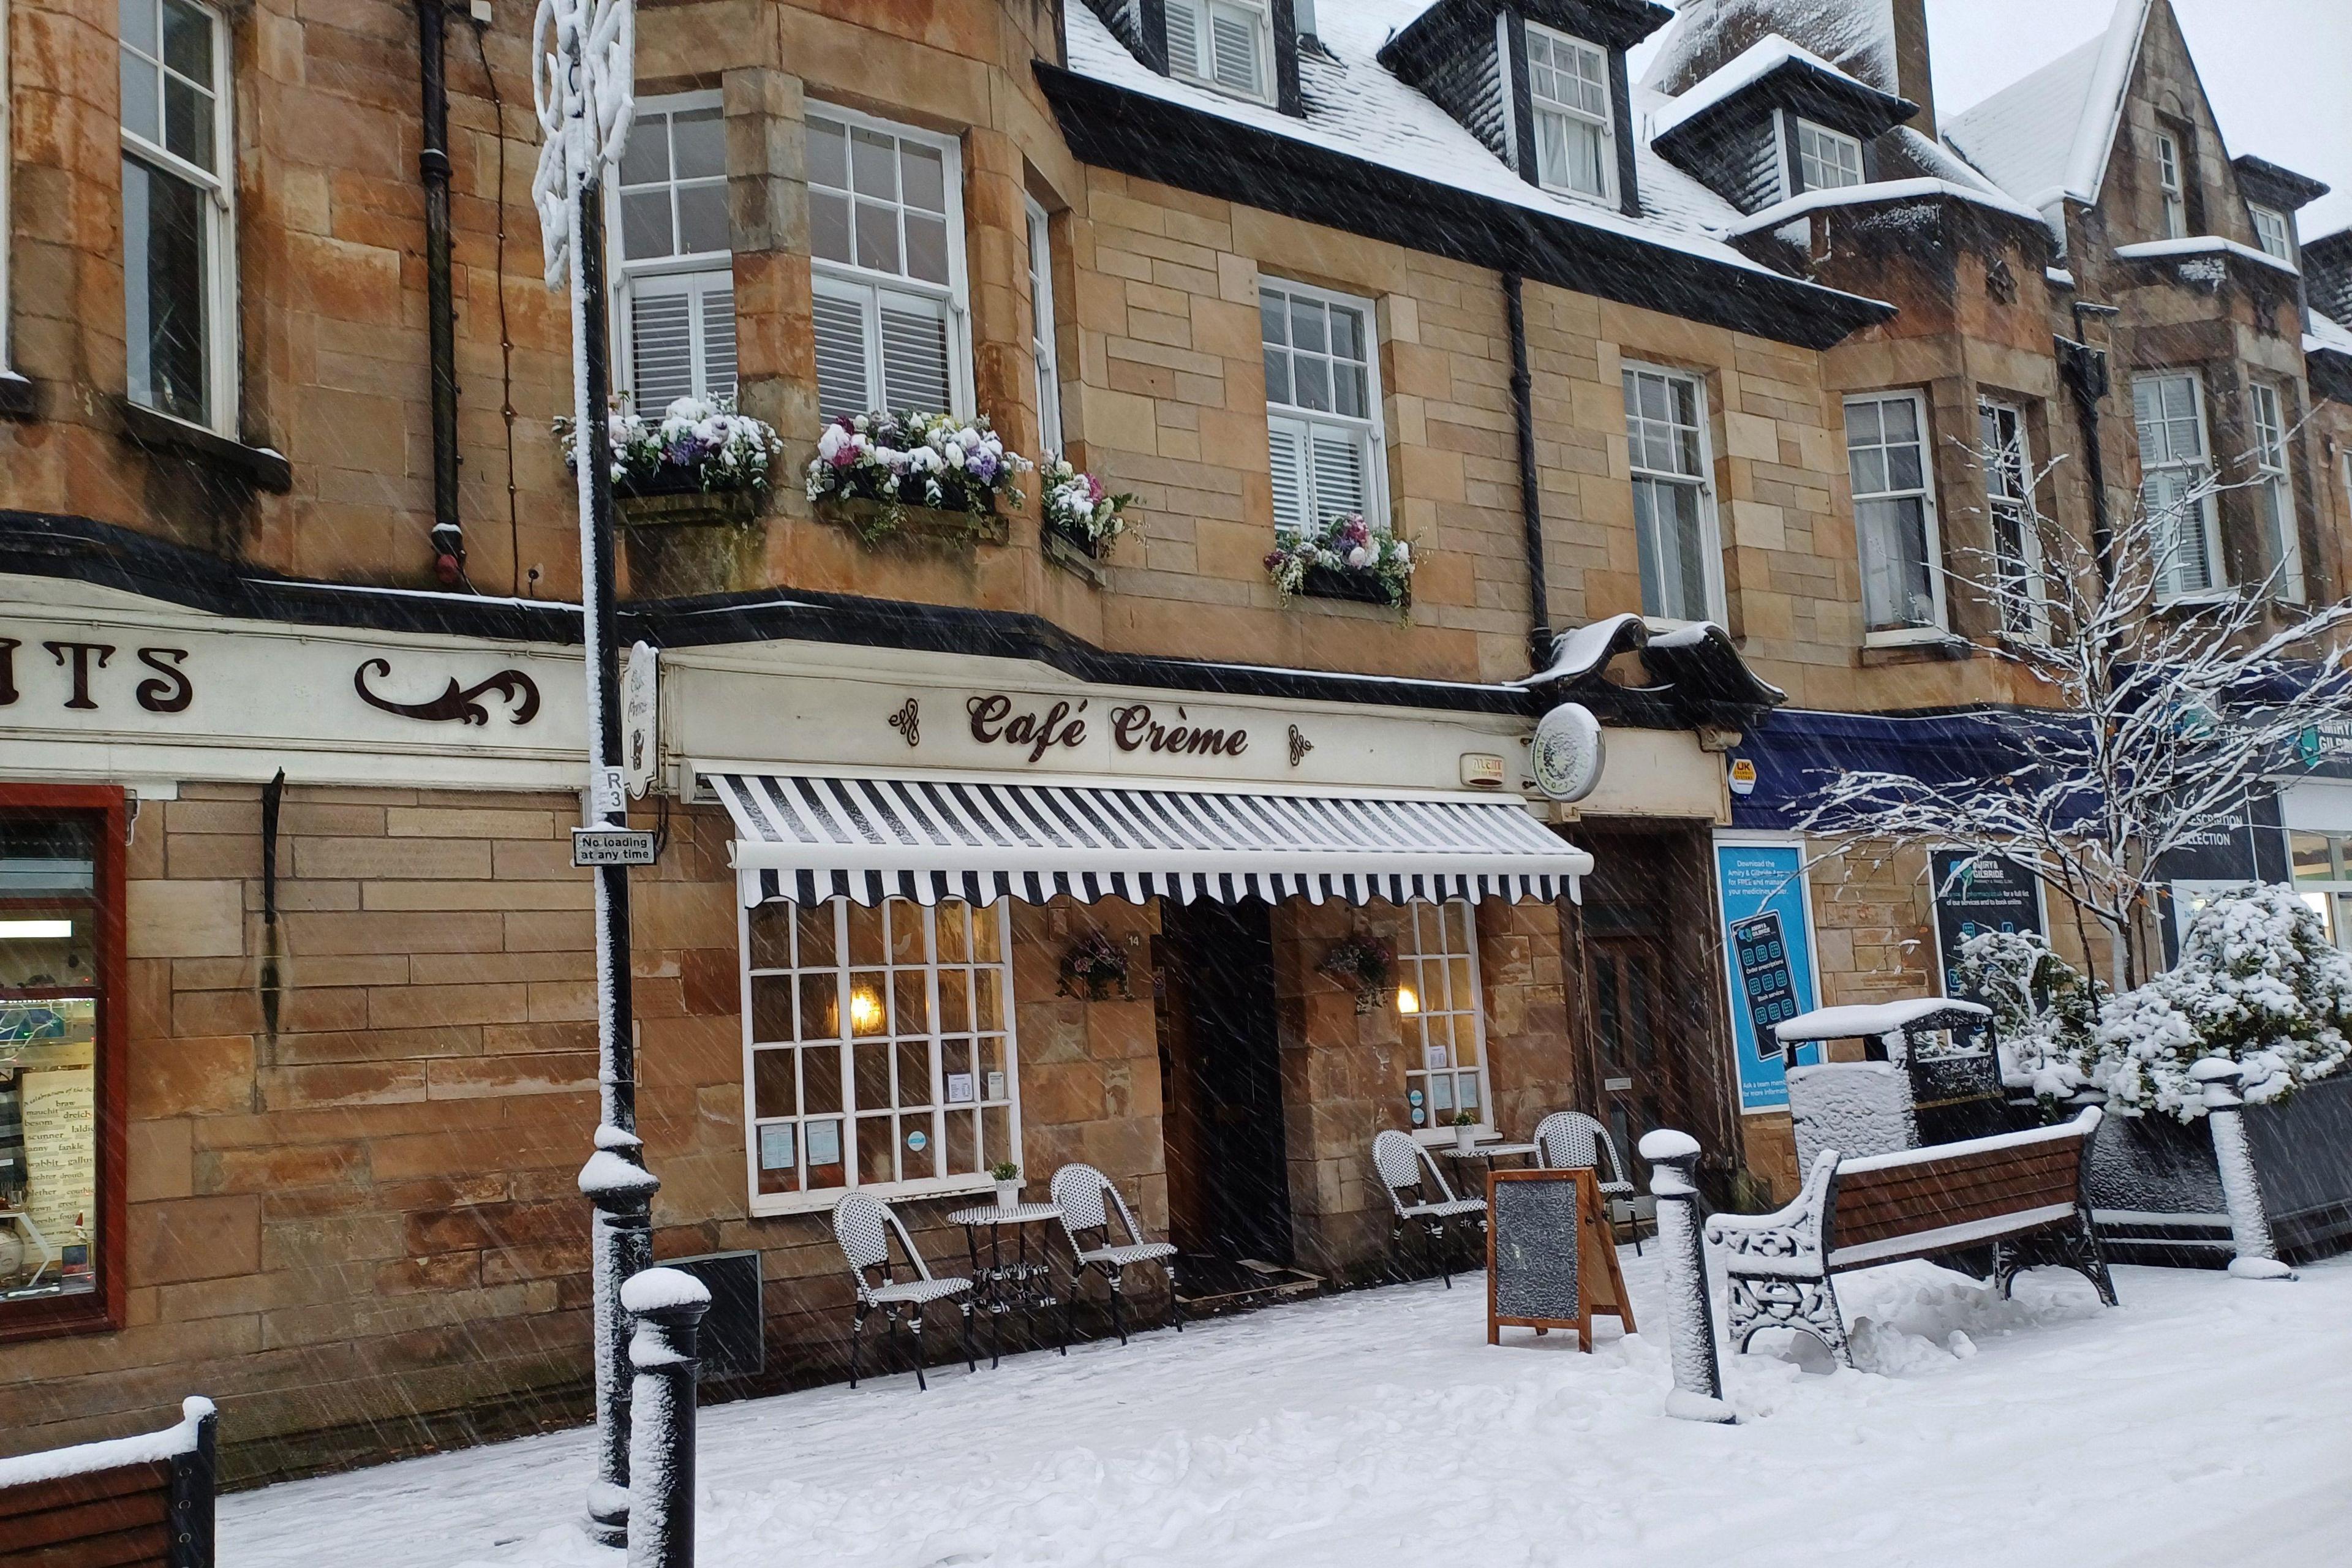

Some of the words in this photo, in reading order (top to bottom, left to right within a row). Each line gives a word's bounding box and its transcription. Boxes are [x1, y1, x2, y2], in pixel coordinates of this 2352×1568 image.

[967, 695, 1088, 763] Café
[1110, 704, 1248, 756] Crème
[1737, 762, 1751, 771] UK
[608, 772, 622, 789] R
[611, 791, 621, 807] 3
[583, 838, 599, 847] No
[604, 837, 647, 848] loading
[598, 852, 619, 861] any
[623, 850, 649, 859] time
[1973, 870, 2004, 878] GILBRIDE
[64, 1110, 92, 1119] dreich
